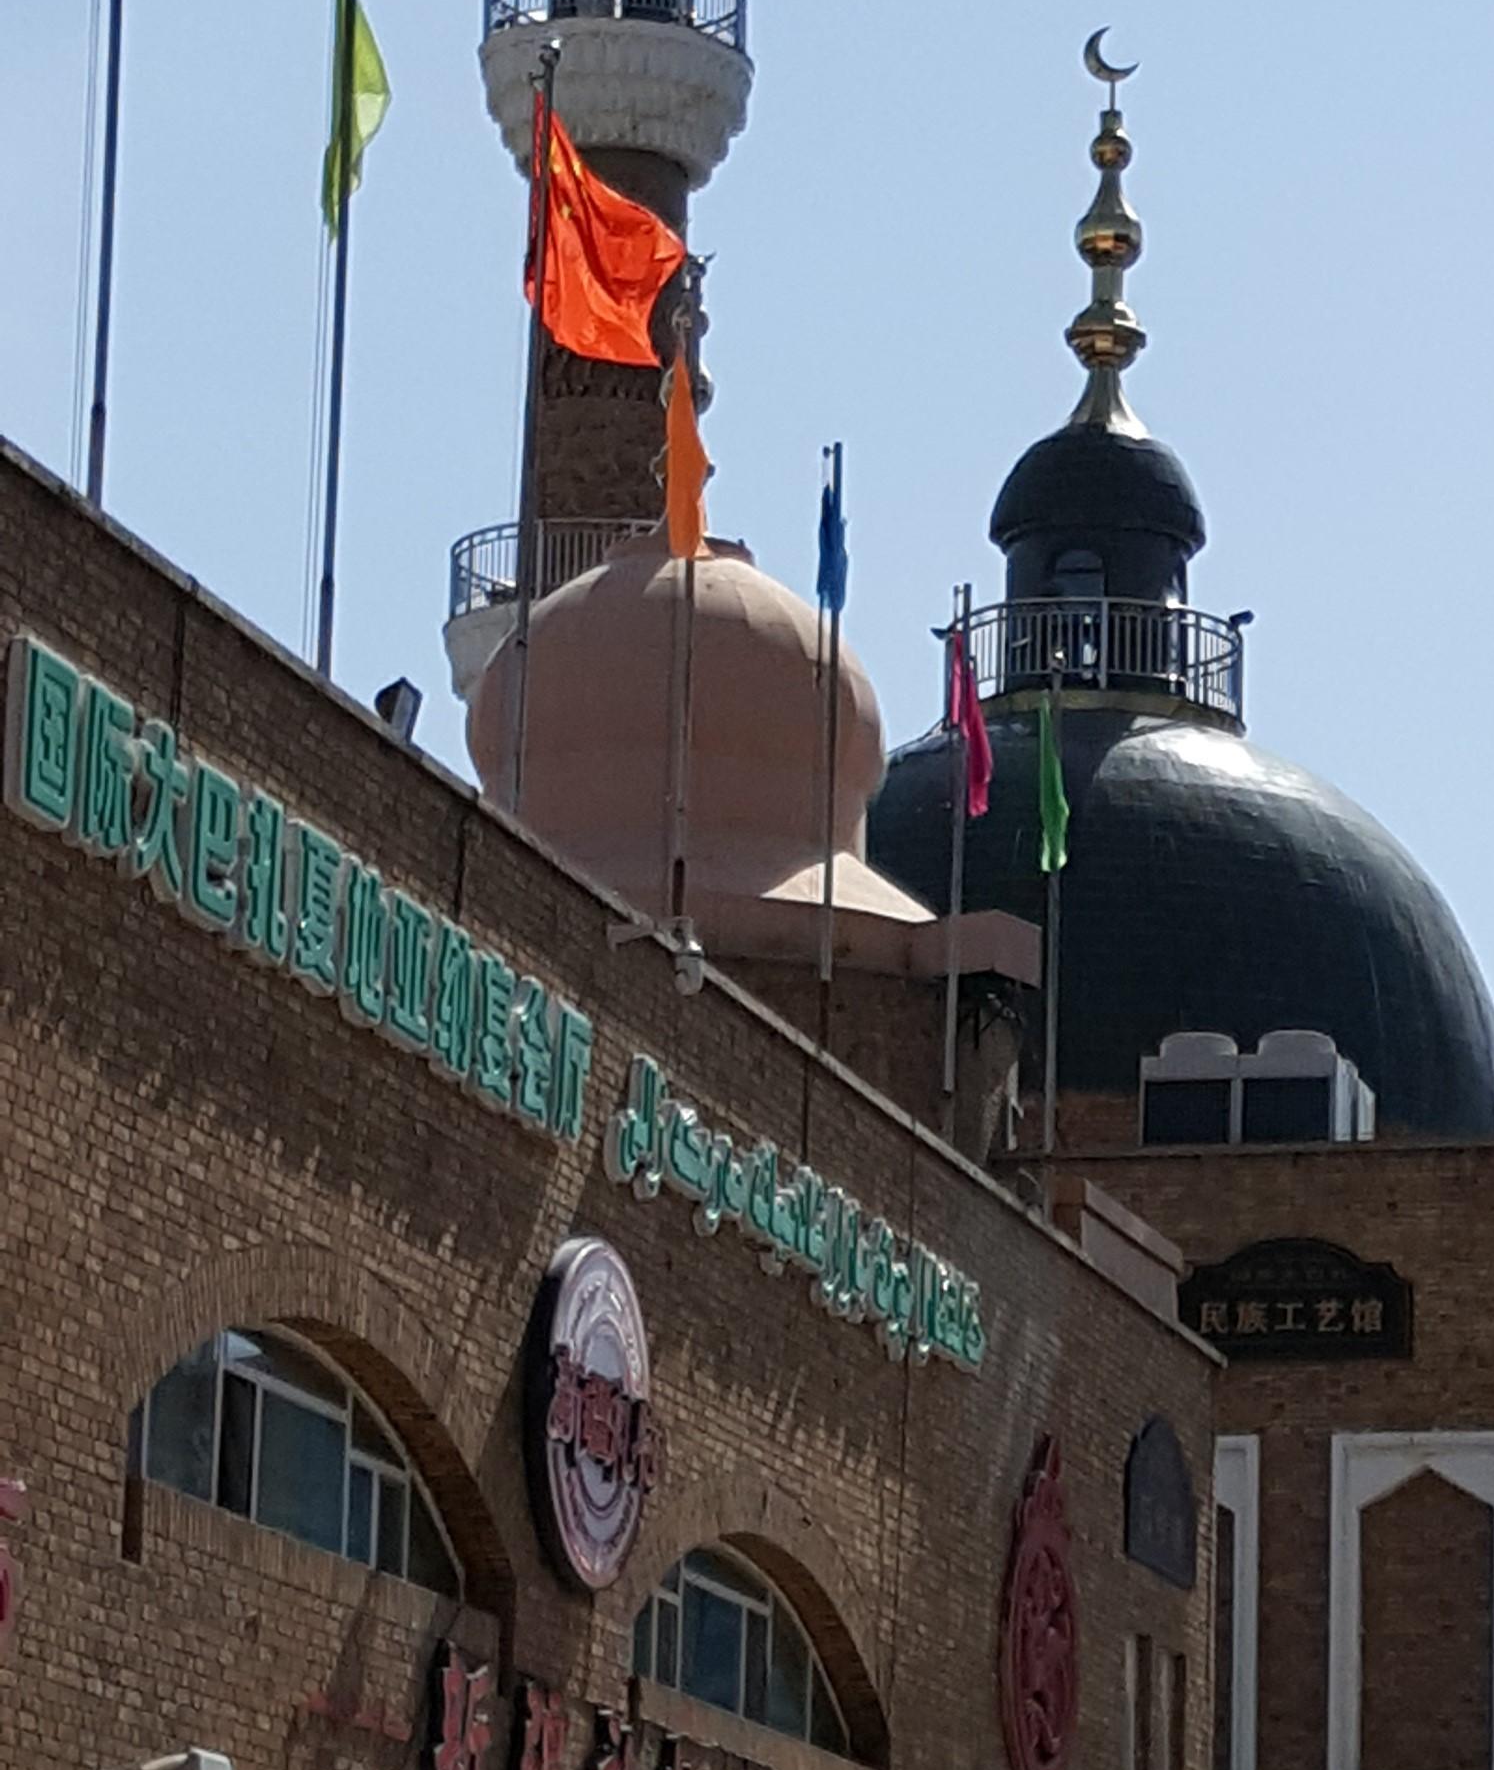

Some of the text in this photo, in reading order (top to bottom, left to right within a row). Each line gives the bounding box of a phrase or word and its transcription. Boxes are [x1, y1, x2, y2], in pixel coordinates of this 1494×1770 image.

[14, 637, 592, 1142] 国际大巴扎夏地亚纳宴会厅
[1199, 1298, 1384, 1334] 民族工艺馆
